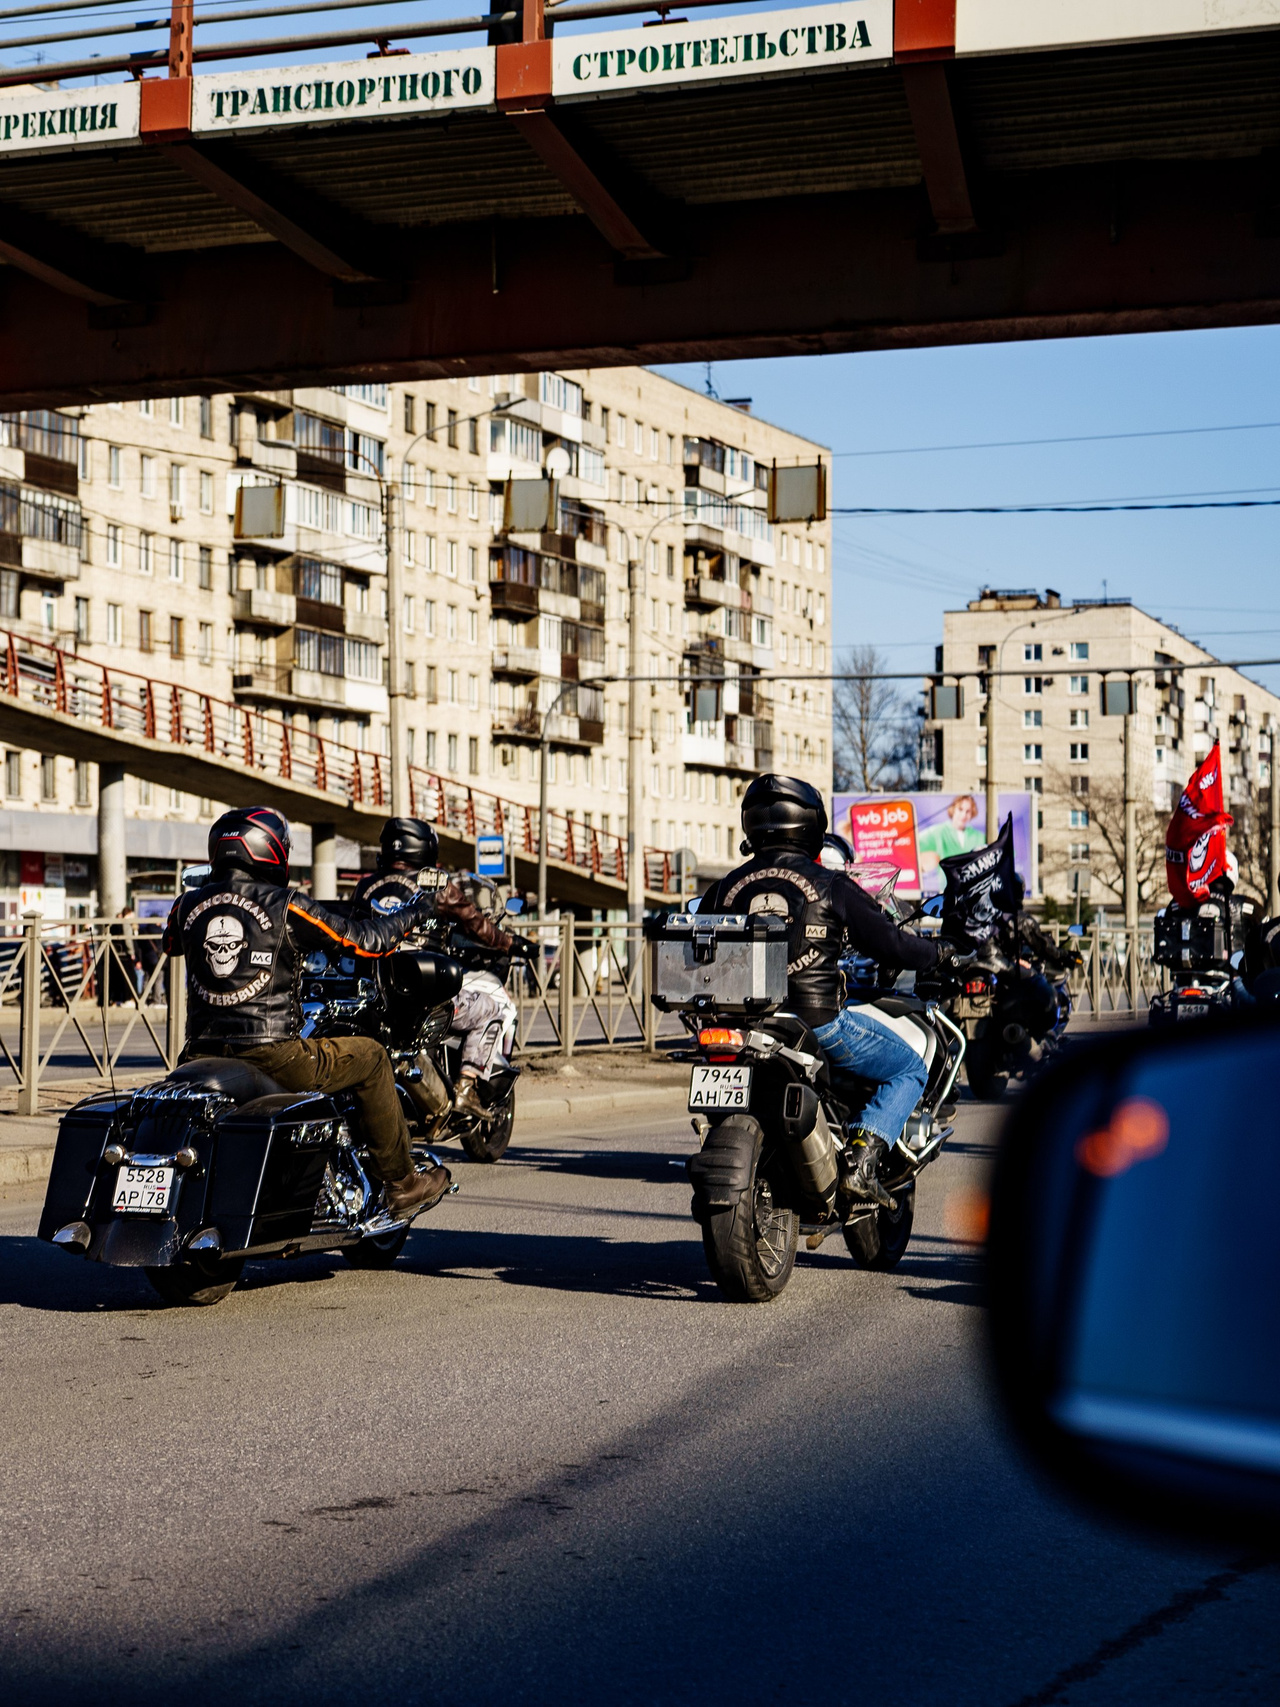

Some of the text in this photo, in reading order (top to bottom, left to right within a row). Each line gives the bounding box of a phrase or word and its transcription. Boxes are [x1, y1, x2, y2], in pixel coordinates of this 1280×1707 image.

[210, 67, 483, 119] ТРАНСПОРТНОГО
[572, 19, 873, 81] СТРОИТЕЛЬСТВА
[856, 808, 909, 828] wb job
[745, 867, 819, 903] HOOLIGANS
[183, 892, 273, 931] THE HOOLIGANS
[806, 927, 826, 937] MC
[251, 953, 272, 963] MC
[700, 1068, 743, 1083] 7944
[724, 1090, 744, 1105] 78
[126, 1168, 165, 1184] 5528
[146, 1191, 165, 1206] 78
